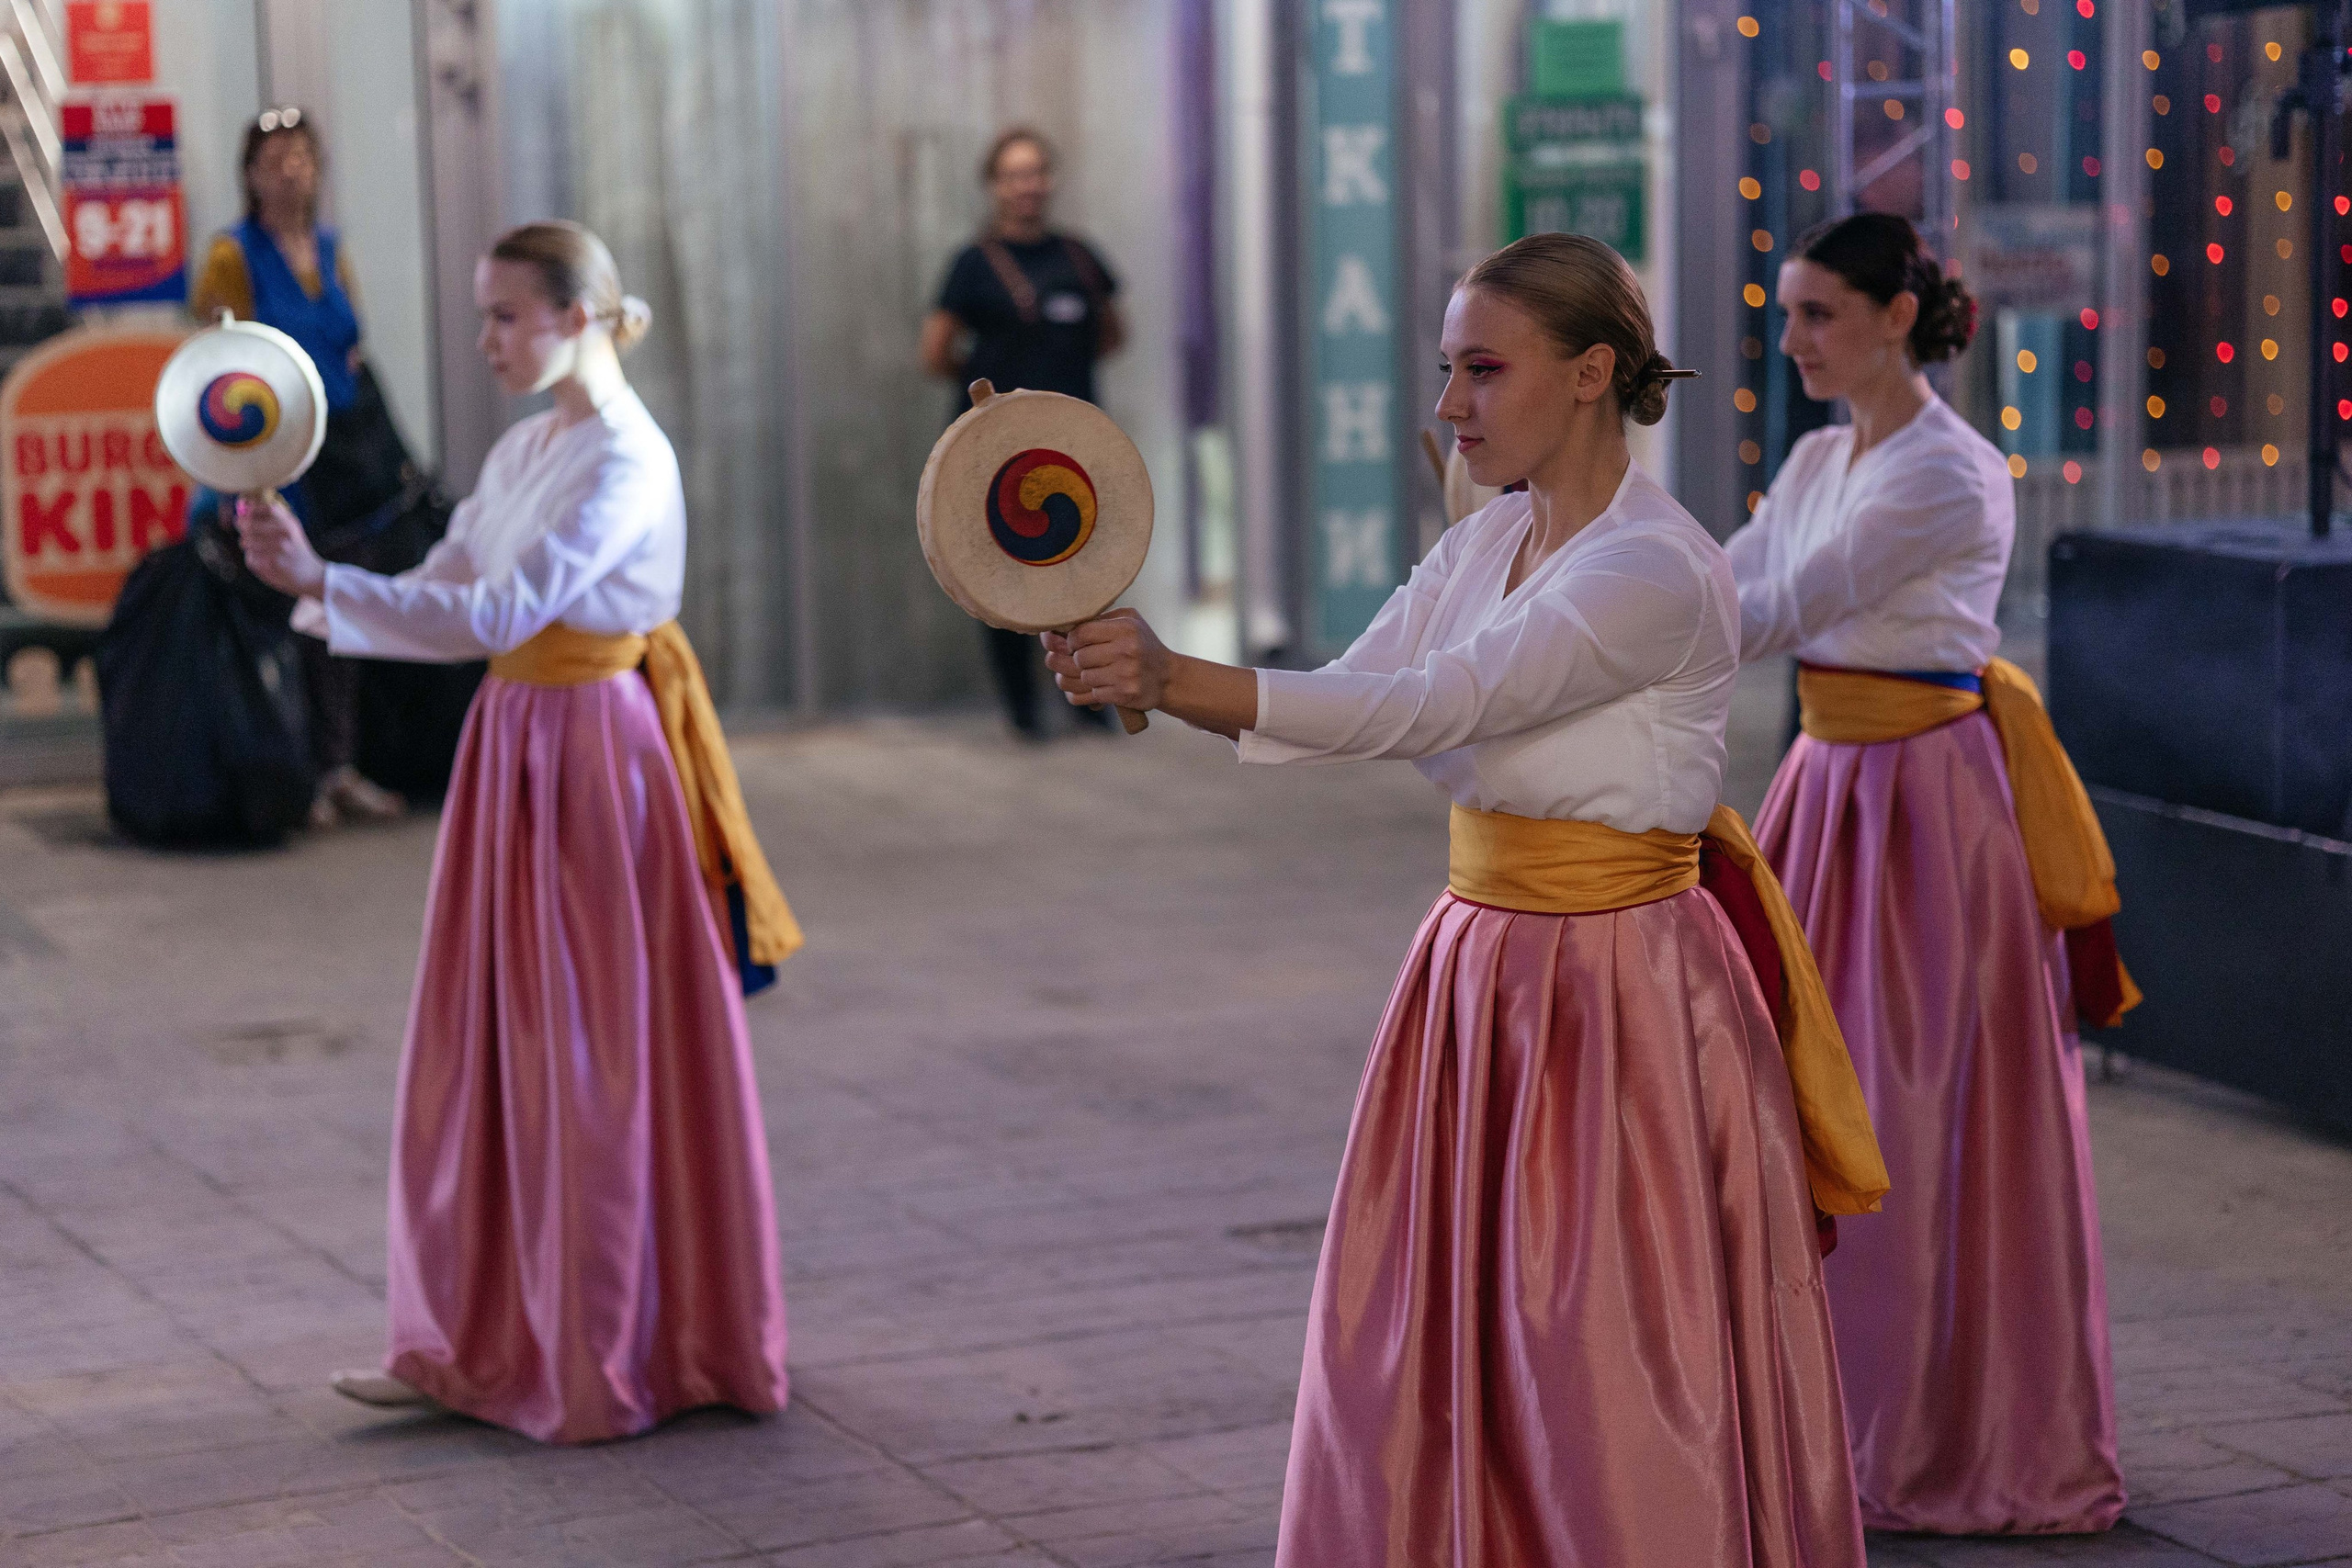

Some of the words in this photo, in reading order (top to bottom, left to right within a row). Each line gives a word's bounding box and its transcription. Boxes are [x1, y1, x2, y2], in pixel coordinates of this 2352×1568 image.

[1320, 0, 1391, 589] ТКАНИ
[16, 428, 180, 477] BURG
[20, 483, 187, 557] KIN
